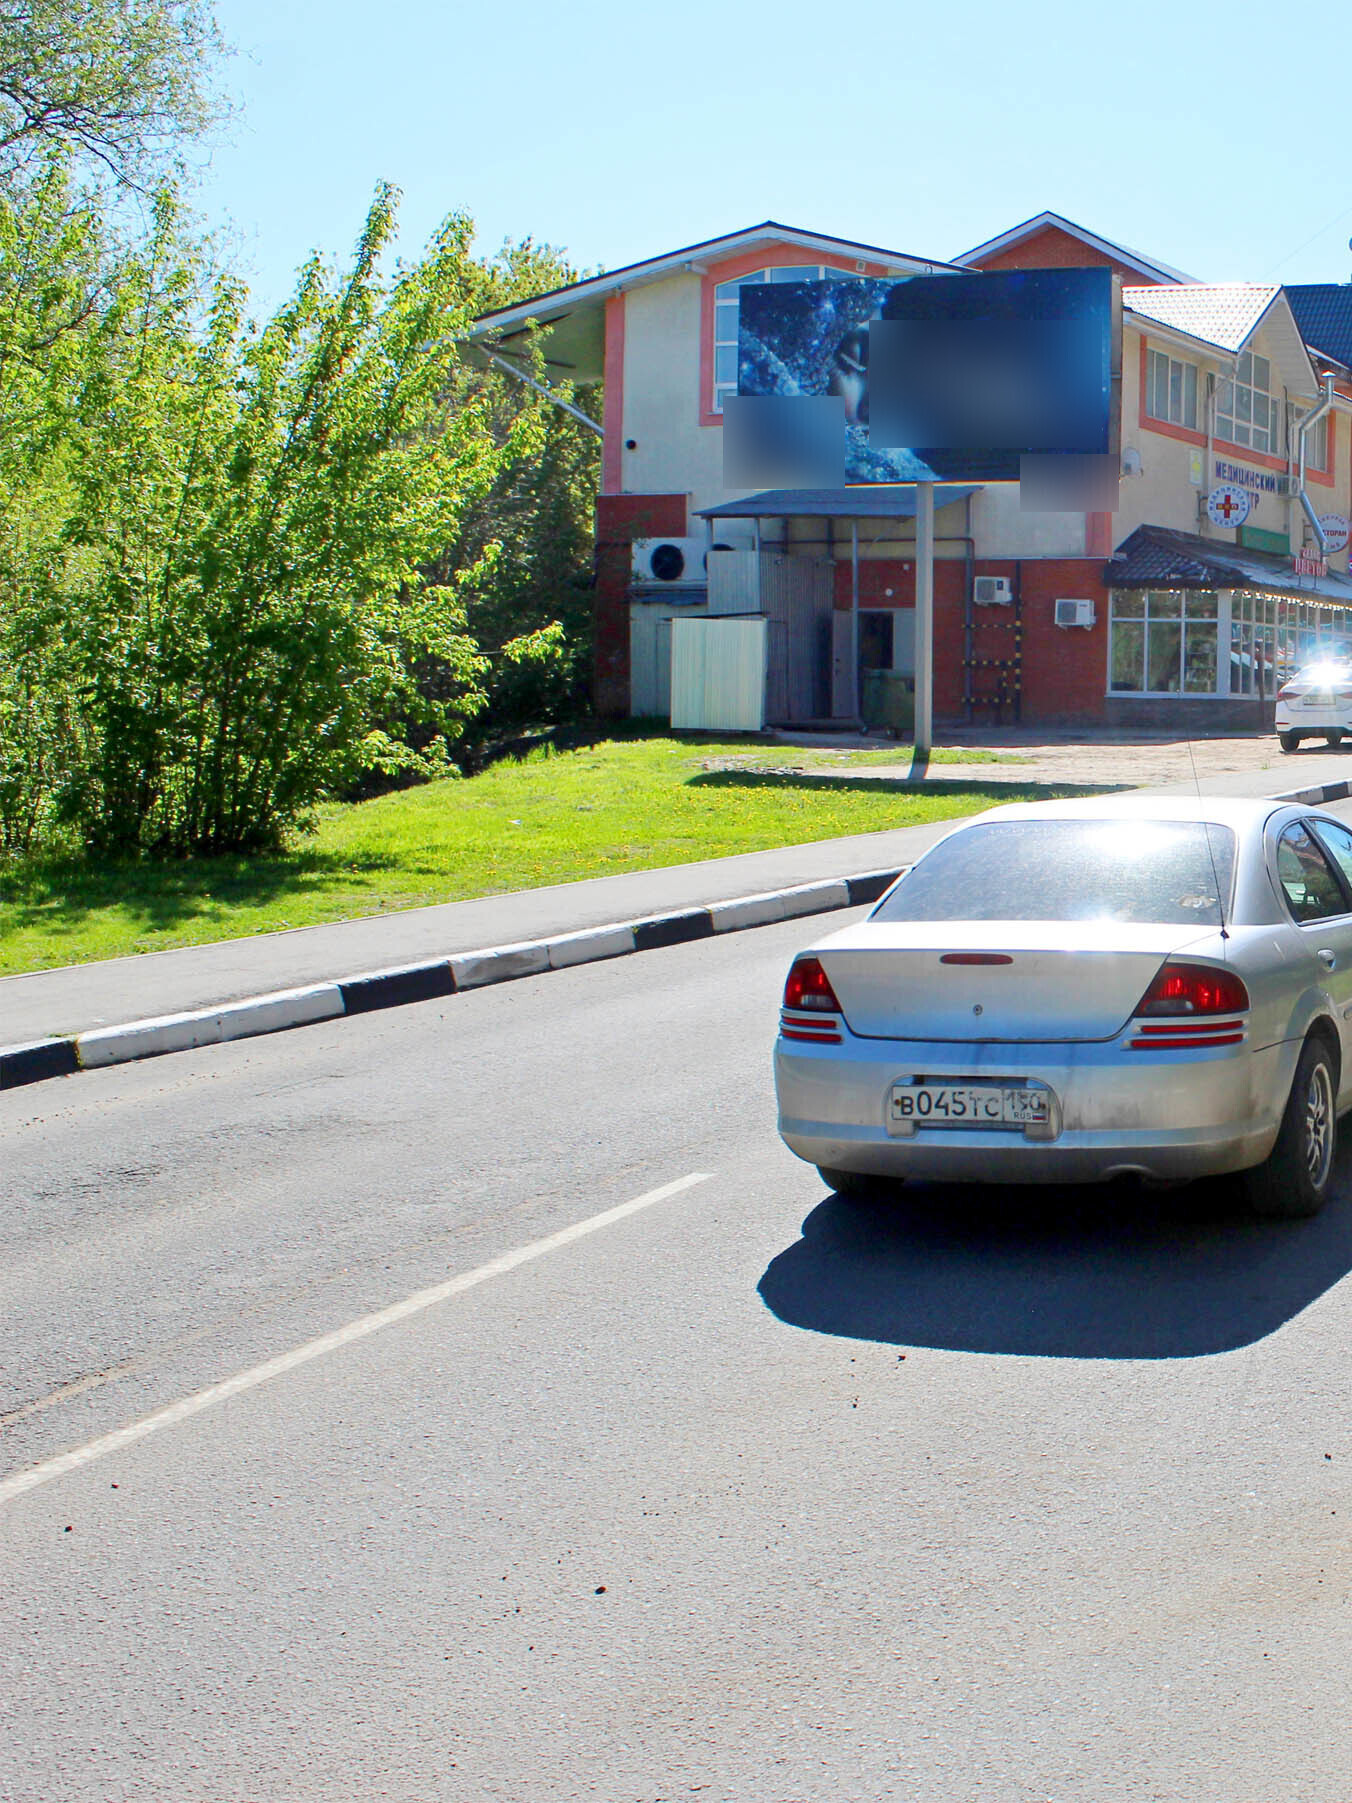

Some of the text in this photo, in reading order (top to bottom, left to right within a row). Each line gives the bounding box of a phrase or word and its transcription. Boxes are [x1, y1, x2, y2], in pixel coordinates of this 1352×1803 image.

[1215, 460, 1275, 493] МЕДИЦИНСКИЙ
[1322, 528, 1347, 537] СТОРАН
[1014, 1111, 1032, 1120] RUS
